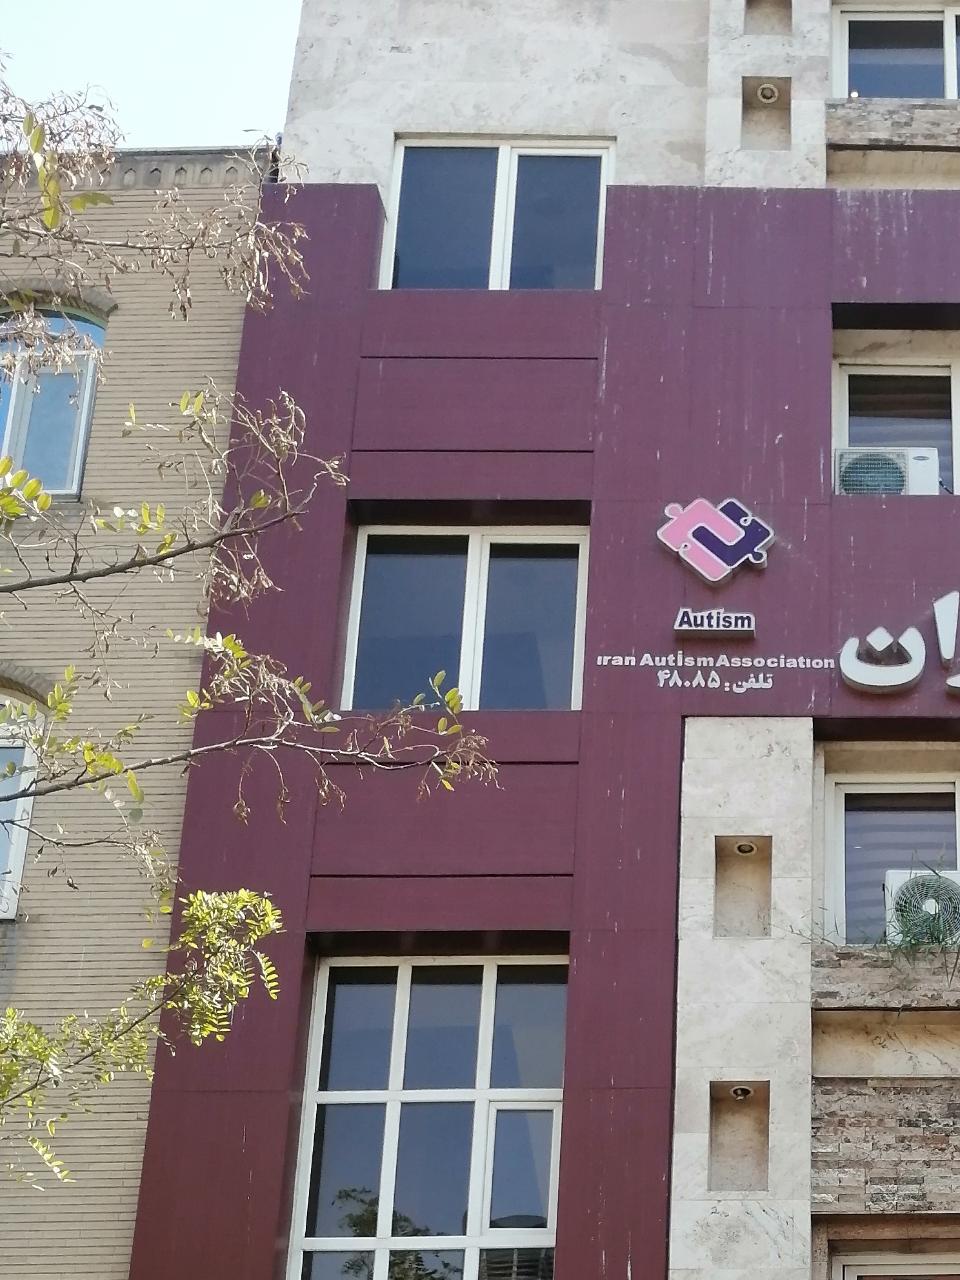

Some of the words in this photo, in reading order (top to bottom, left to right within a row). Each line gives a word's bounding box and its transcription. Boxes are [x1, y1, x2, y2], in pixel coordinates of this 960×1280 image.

[678, 610, 752, 629] Autism
[639, 651, 714, 668] Autism
[715, 654, 835, 669] Association
